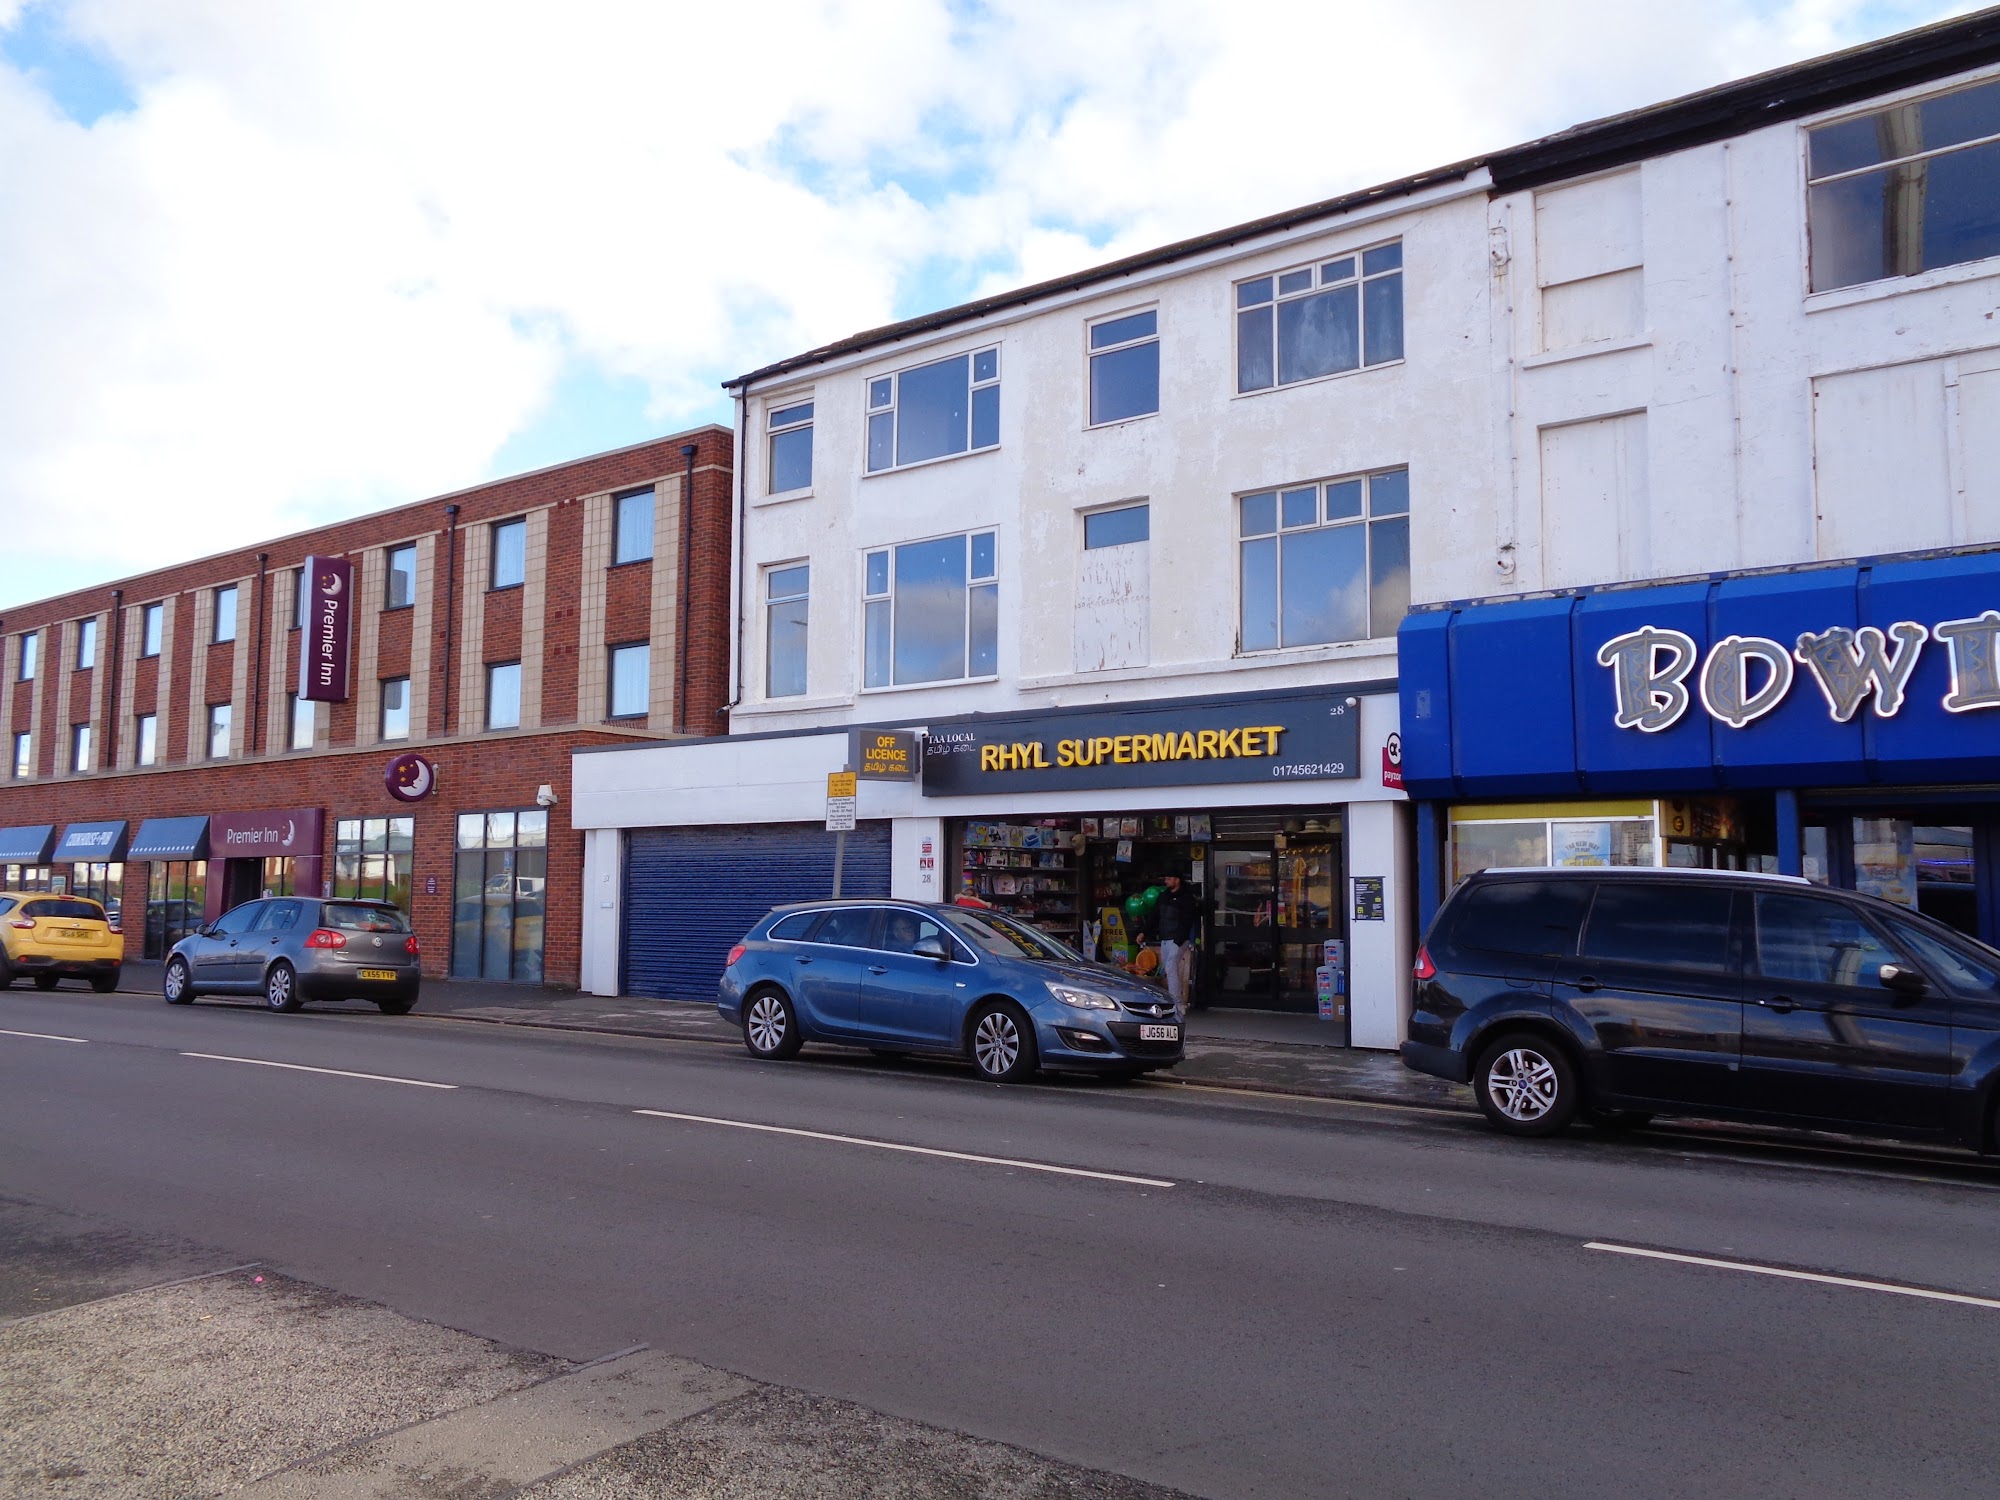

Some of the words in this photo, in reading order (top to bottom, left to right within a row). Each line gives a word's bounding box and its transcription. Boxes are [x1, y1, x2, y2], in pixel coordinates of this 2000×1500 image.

[322, 599, 338, 660] Premier
[320, 662, 336, 686] Inn
[1330, 705, 1344, 715] 28
[877, 736, 896, 748] OFF
[928, 735, 945, 744] TAA
[947, 732, 976, 743] LOCAL
[866, 748, 906, 761] LICENCE
[981, 742, 1050, 771] RHYL
[1057, 725, 1285, 767] SUPERMARKET
[1272, 762, 1344, 777] 01745621429
[227, 827, 263, 844] Premier
[264, 826, 278, 843] Inn
[922, 874, 932, 883] 28
[1146, 1026, 1165, 1038] JG56
